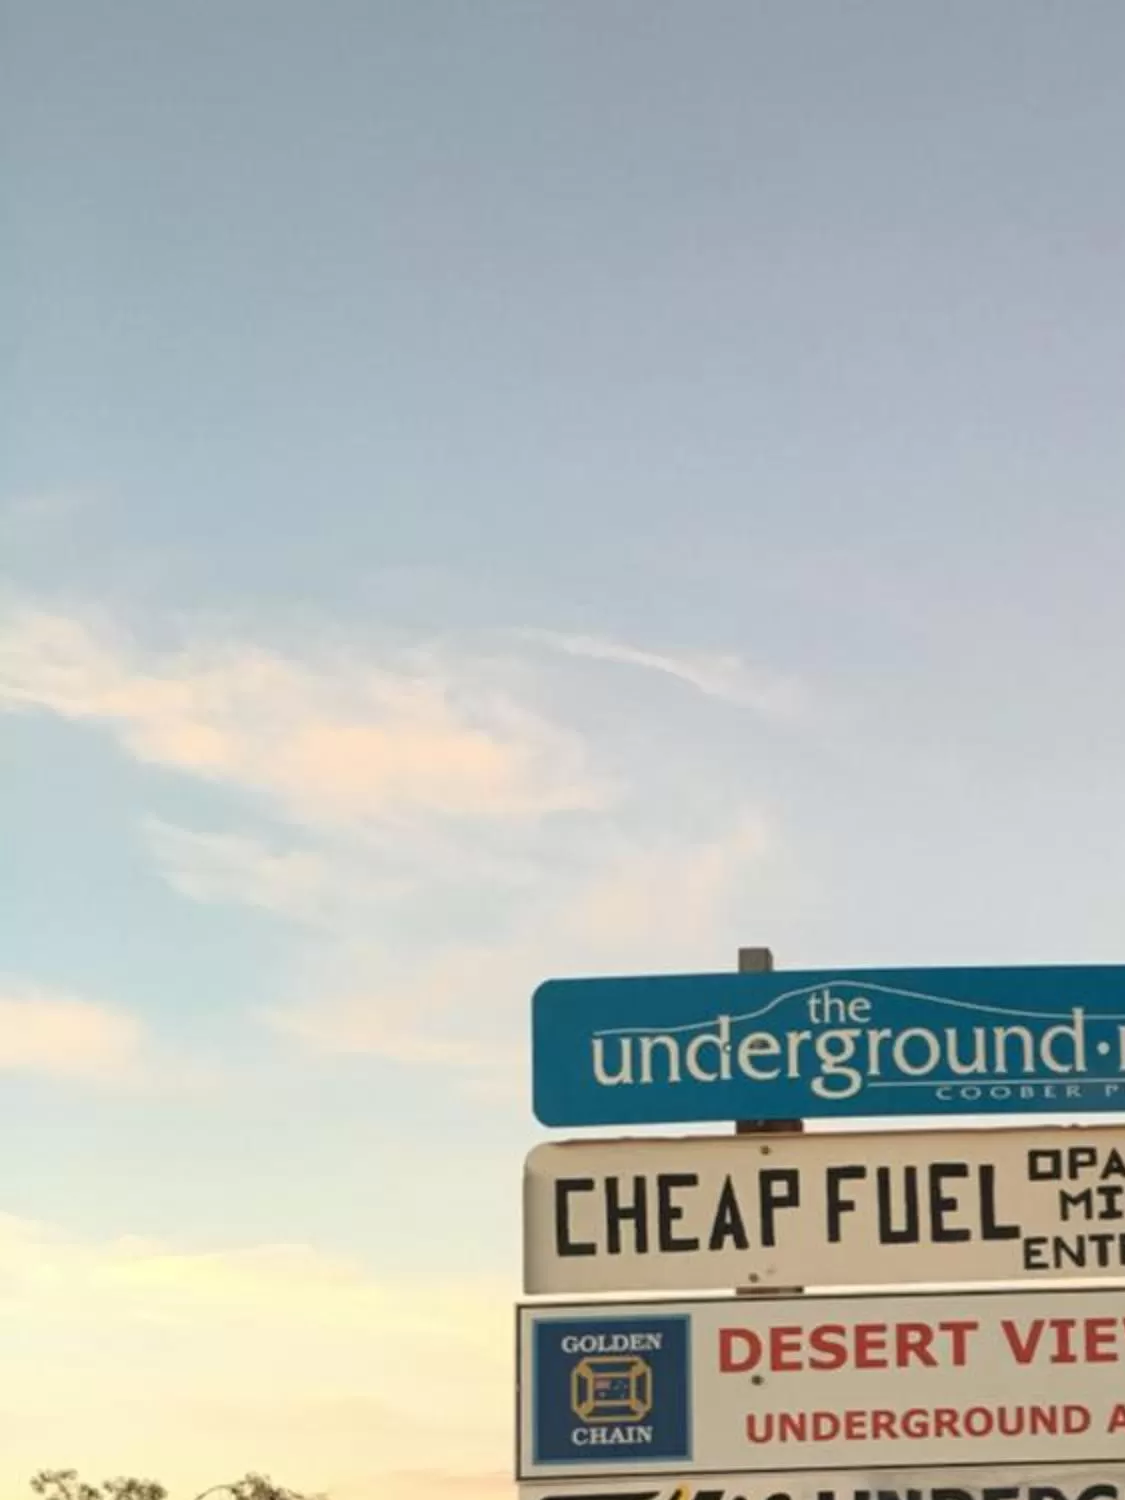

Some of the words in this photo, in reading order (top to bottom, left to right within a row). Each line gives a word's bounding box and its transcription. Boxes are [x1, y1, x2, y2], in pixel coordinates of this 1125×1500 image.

[808, 990, 872, 1024] the
[936, 1085, 1082, 1101] COOBER
[555, 1168, 799, 1257] CHEAP
[827, 1163, 1020, 1243] FUEL
[561, 1333, 663, 1353] GOLDEN
[719, 1320, 978, 1374] DESERT
[571, 1426, 653, 1445] CHAIN
[746, 1405, 1090, 1443] UNDERGROUND
